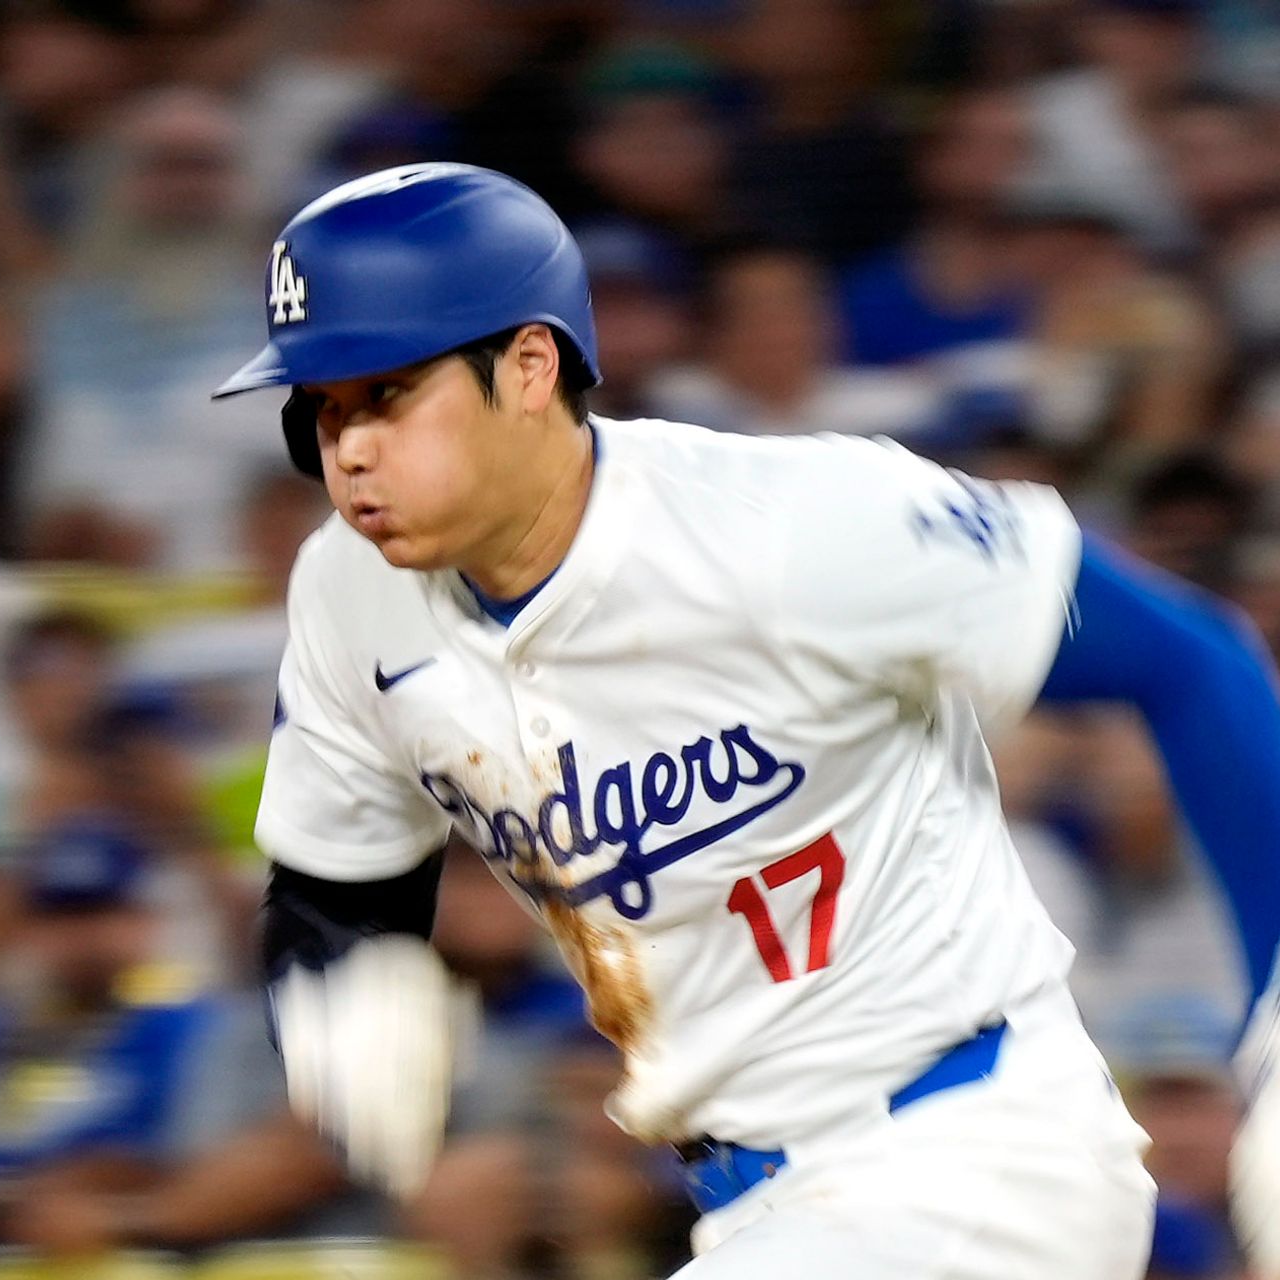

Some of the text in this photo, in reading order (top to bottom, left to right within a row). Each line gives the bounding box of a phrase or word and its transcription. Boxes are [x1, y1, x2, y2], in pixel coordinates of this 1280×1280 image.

[269, 240, 305, 324] LA
[422, 724, 807, 920] Dodgers
[727, 830, 847, 984] 17
